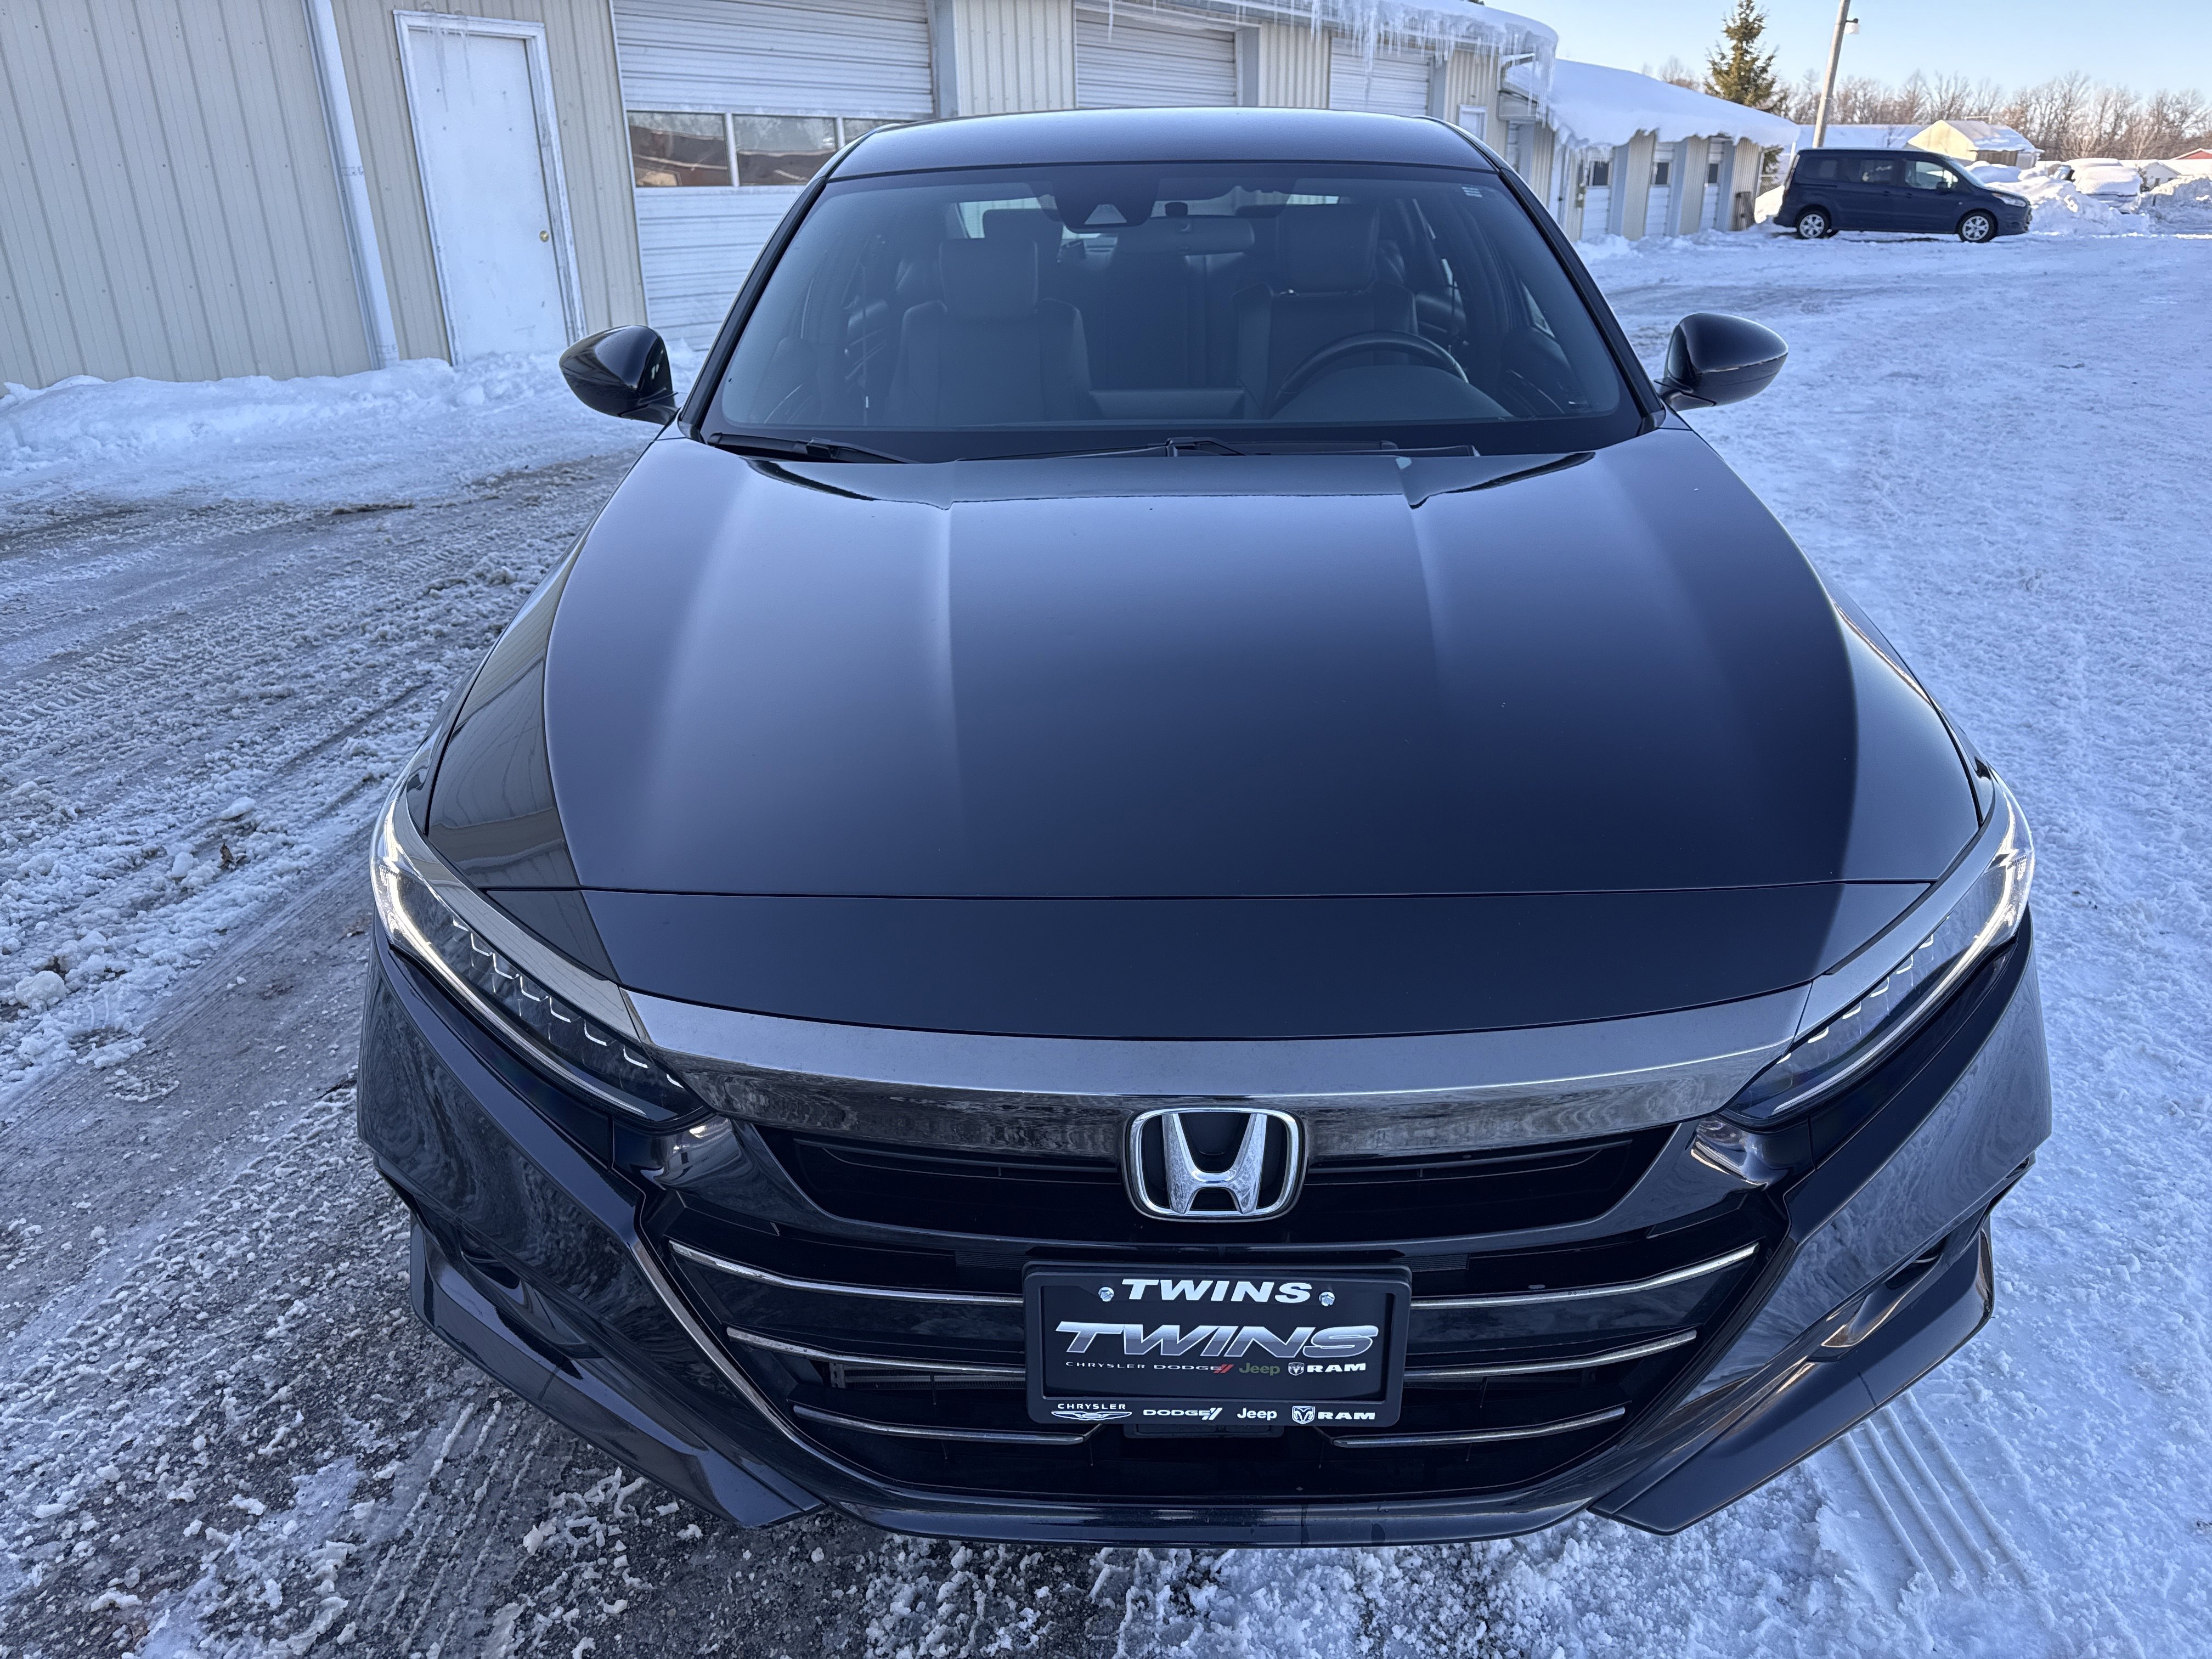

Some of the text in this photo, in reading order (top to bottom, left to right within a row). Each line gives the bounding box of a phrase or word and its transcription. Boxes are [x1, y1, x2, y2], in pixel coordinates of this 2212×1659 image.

[1122, 1279, 1312, 1304] TWINS
[1056, 1321, 1379, 1358] TWINS
[1239, 1363, 1280, 1376] Jeep
[1307, 1363, 1366, 1373] RAM
[1237, 1408, 1277, 1421] Jeep
[1317, 1412, 1376, 1420] RAM
